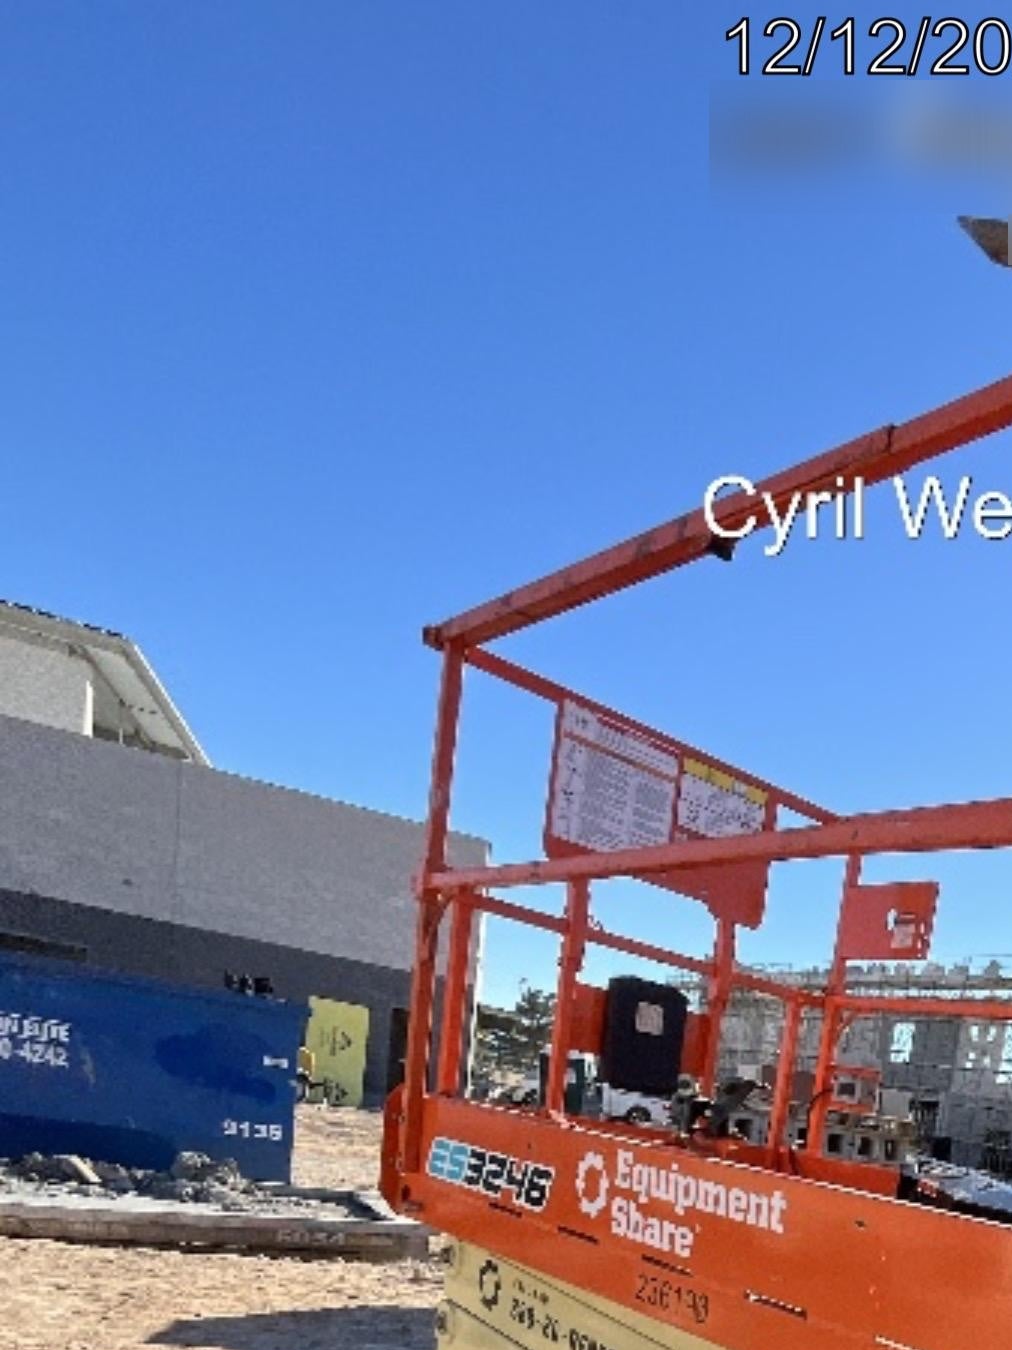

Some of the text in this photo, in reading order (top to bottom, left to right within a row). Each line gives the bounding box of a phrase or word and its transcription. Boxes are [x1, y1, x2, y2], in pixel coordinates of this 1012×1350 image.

[427, 1137, 555, 1212] ES3246
[614, 1148, 788, 1234] Equipment
[611, 1196, 694, 1258] Share
